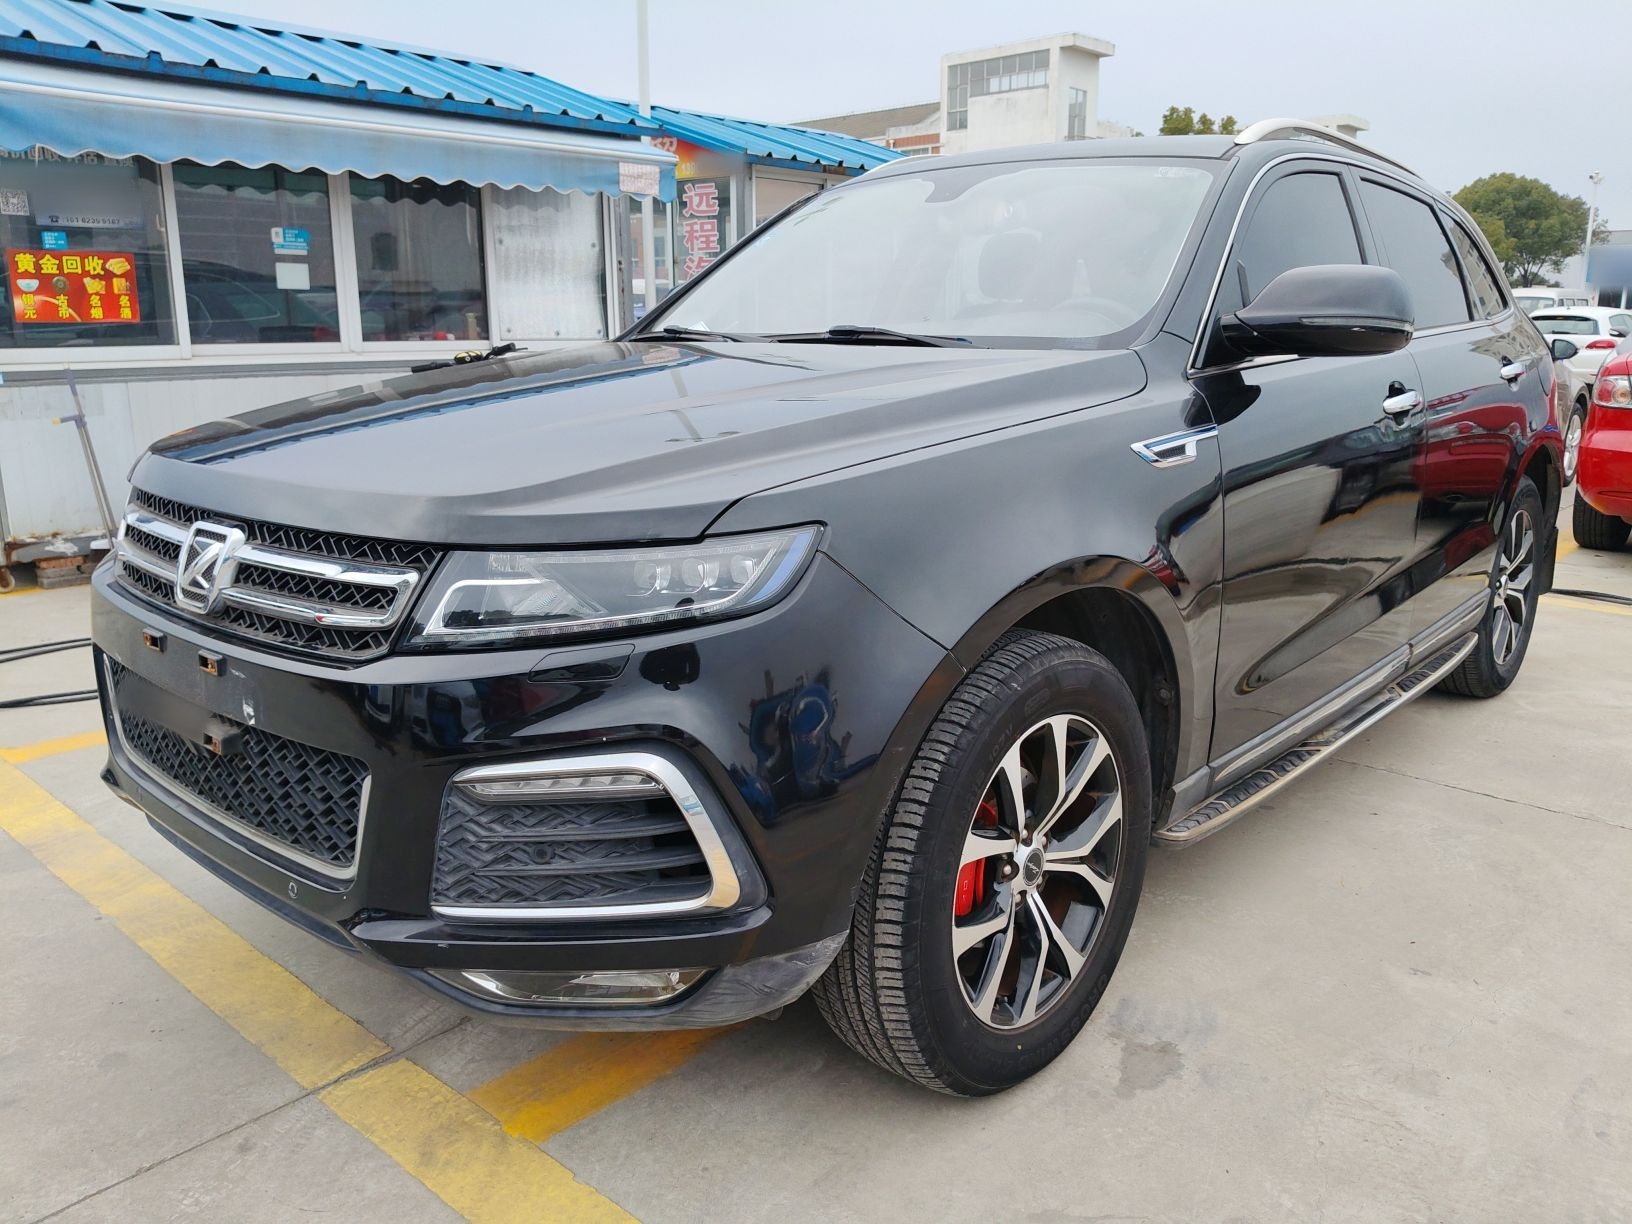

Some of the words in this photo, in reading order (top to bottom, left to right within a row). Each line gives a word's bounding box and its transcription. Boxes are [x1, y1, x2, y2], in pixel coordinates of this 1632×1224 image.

[15, 253, 104, 275] 黄金回收
[90, 294, 103, 319] 名烟
[120, 294, 132, 319] 名酒
